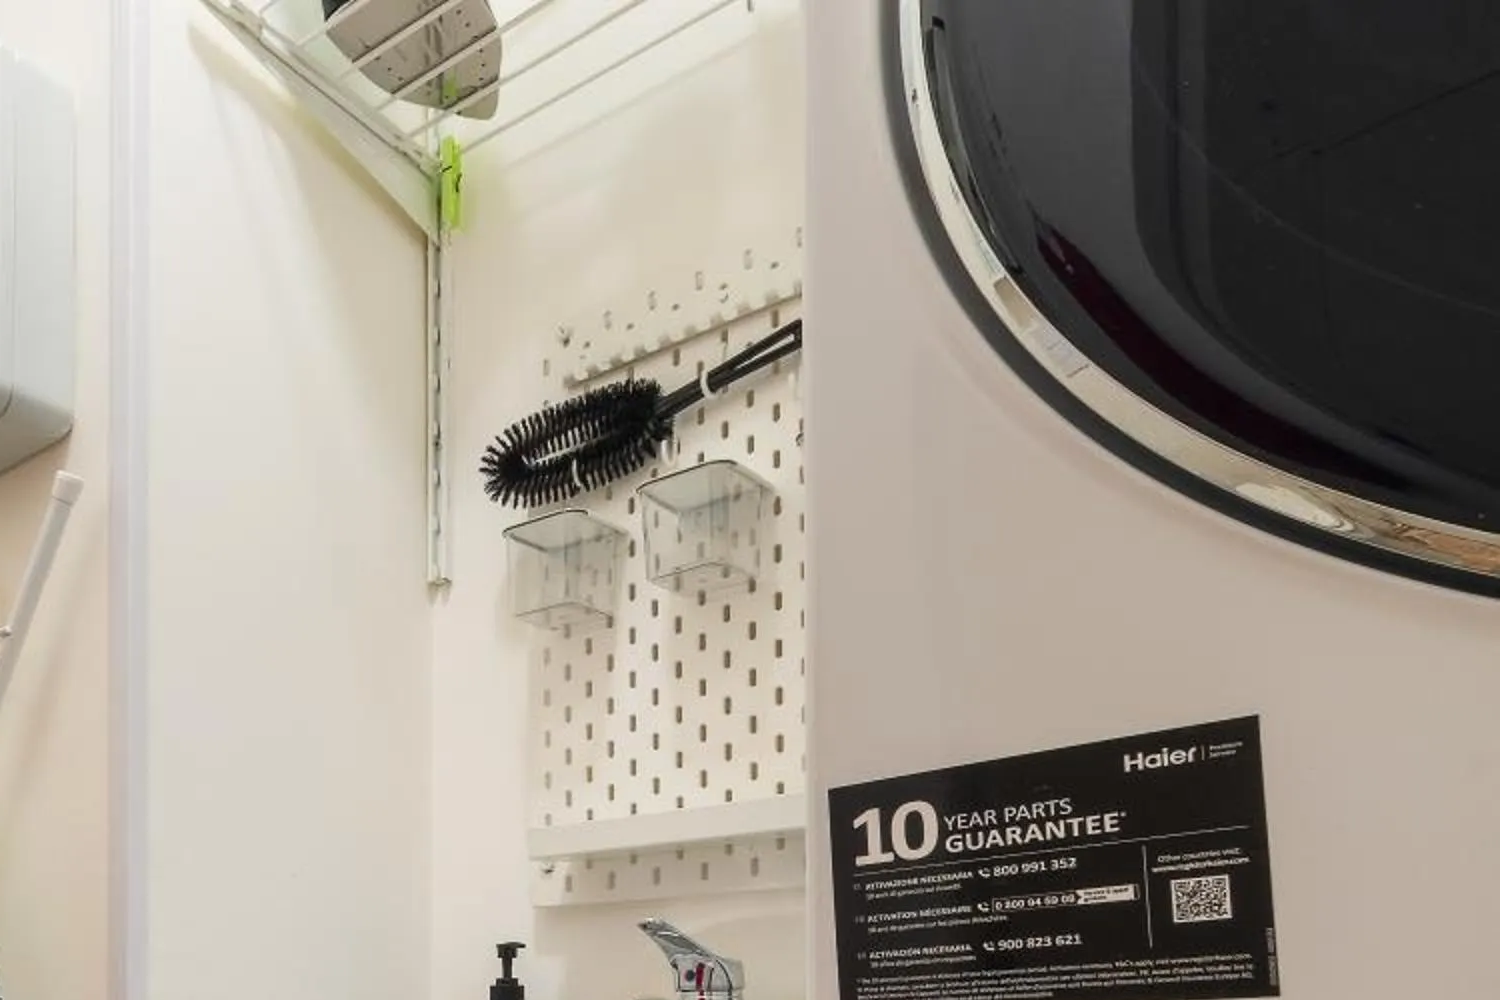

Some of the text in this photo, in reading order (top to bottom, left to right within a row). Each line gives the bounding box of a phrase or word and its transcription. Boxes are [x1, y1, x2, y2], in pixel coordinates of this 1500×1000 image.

[1123, 746, 1197, 773] Haier
[943, 797, 1073, 831] YEAR PARTS
[852, 800, 939, 867] 10
[992, 864, 1018, 878] 800
[1050, 857, 1078, 871] 352
[997, 938, 1024, 951] 900
[1026, 935, 1053, 949] 823
[1055, 932, 1083, 947] 621
